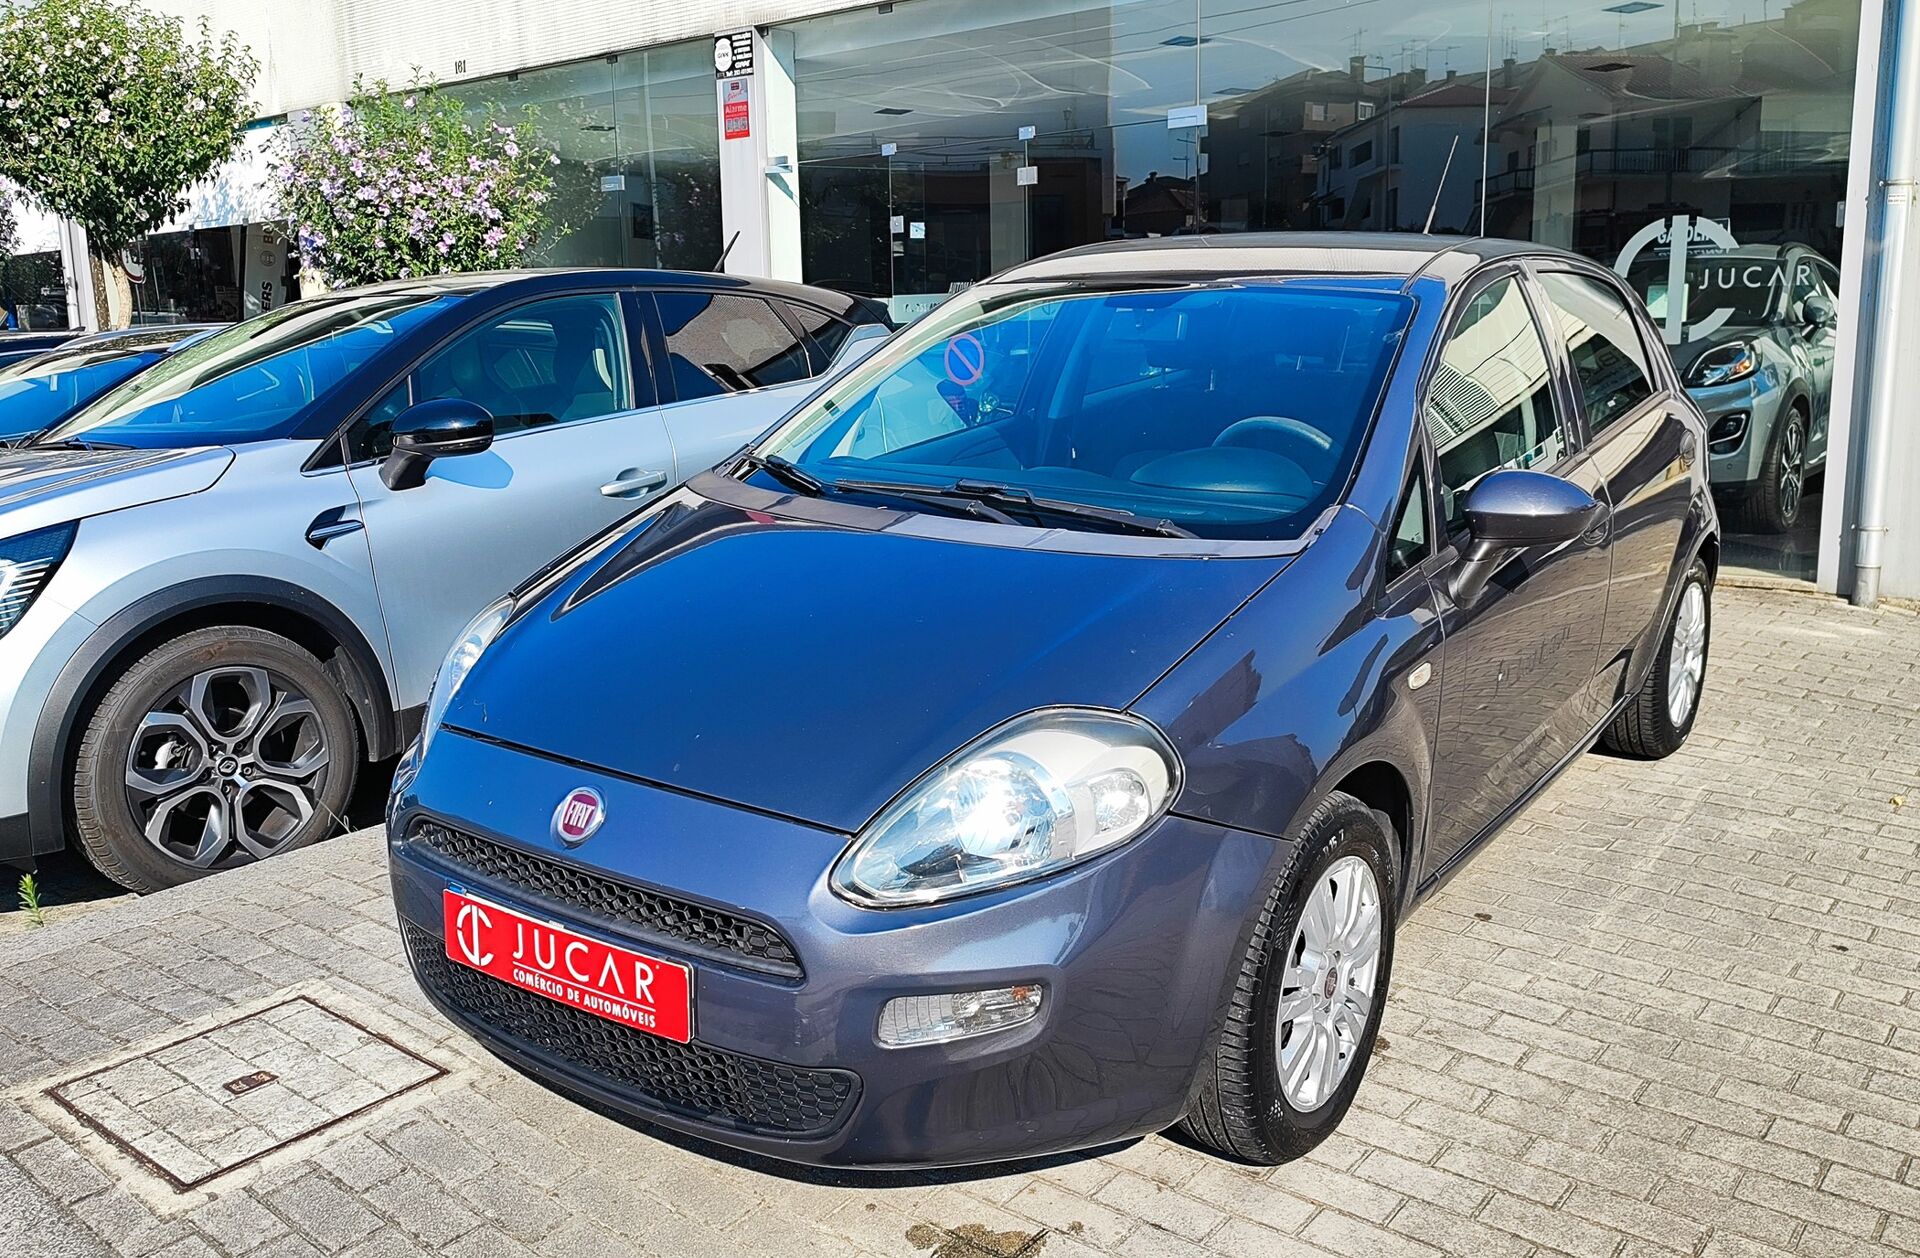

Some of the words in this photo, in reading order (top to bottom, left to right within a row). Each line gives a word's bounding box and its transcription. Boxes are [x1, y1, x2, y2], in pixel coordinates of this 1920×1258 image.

[1698, 265, 1811, 290] JUCAR
[262, 281, 273, 313] ERS
[564, 800, 595, 829] FIAT
[512, 923, 655, 1004] JUCAR
[513, 968, 564, 997] COMÉRCIO
[567, 988, 580, 1003] DE
[583, 994, 656, 1028] AUTOMÓVEIS
